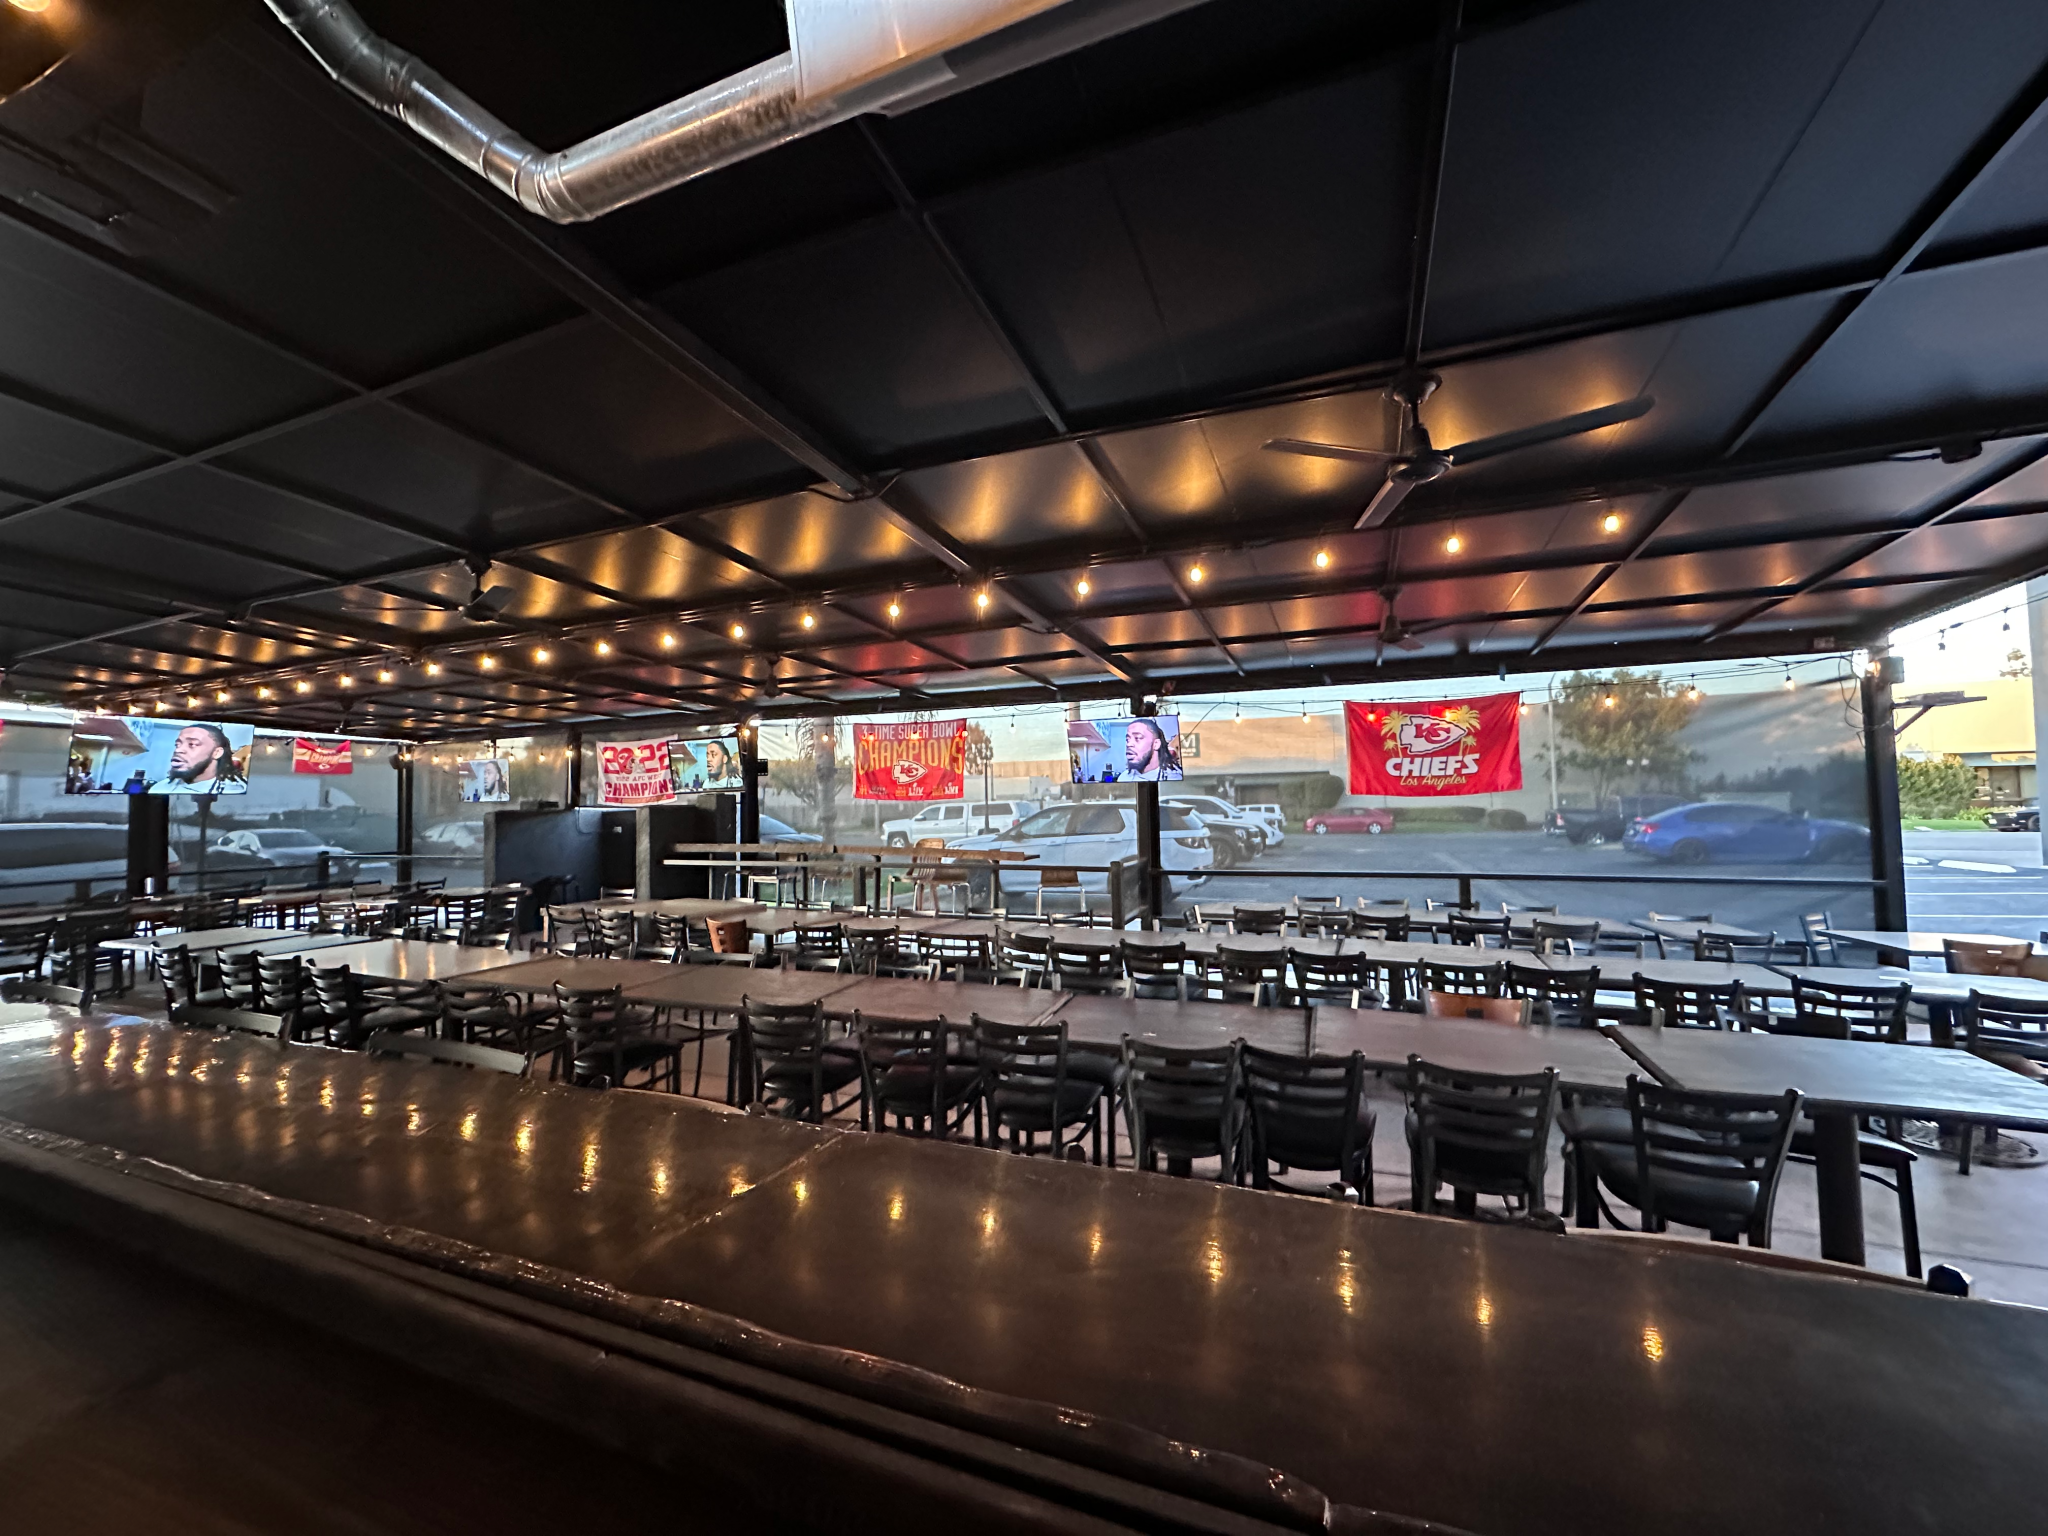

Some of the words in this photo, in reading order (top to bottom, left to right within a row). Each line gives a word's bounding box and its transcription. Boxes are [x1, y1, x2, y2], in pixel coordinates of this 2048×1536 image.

[899, 723, 929, 739] SUPER
[932, 722, 960, 738] BOWL
[1413, 722, 1450, 744] KC
[858, 737, 963, 775] CHAMPIONS
[1385, 753, 1480, 777] CHIEFS
[1400, 775, 1418, 786] Los
[1422, 774, 1467, 790] Angeles
